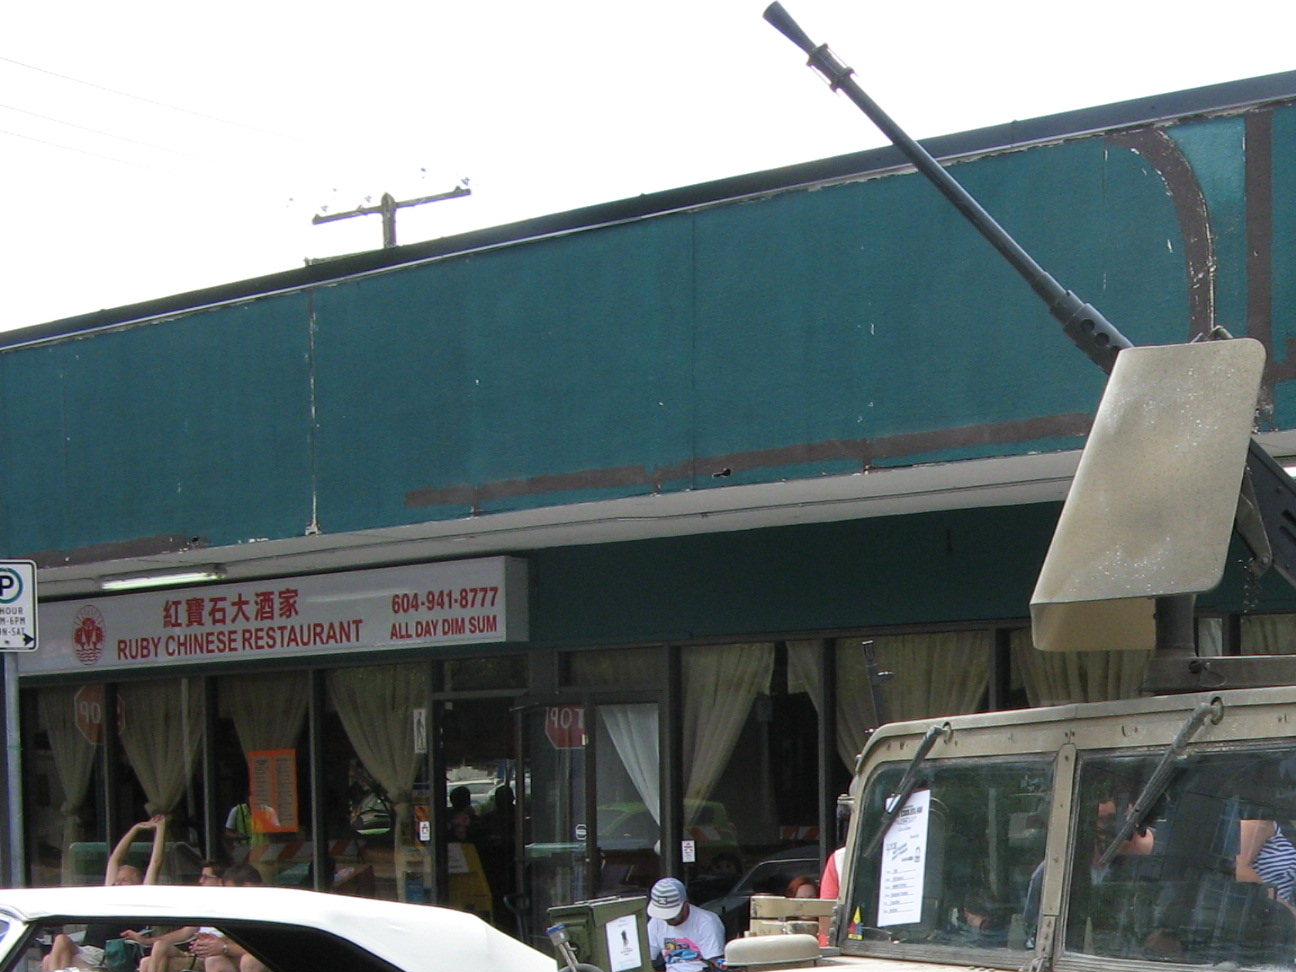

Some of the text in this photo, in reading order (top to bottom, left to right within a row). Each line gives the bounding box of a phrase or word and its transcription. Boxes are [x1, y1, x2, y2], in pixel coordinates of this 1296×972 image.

[163, 588, 299, 629] 紅寶石大酒家
[391, 586, 499, 614] 604-941-8777
[117, 619, 363, 661] RUBY CHINESE RESTAURANT
[390, 615, 497, 640] ALL DAY DIM SUM
